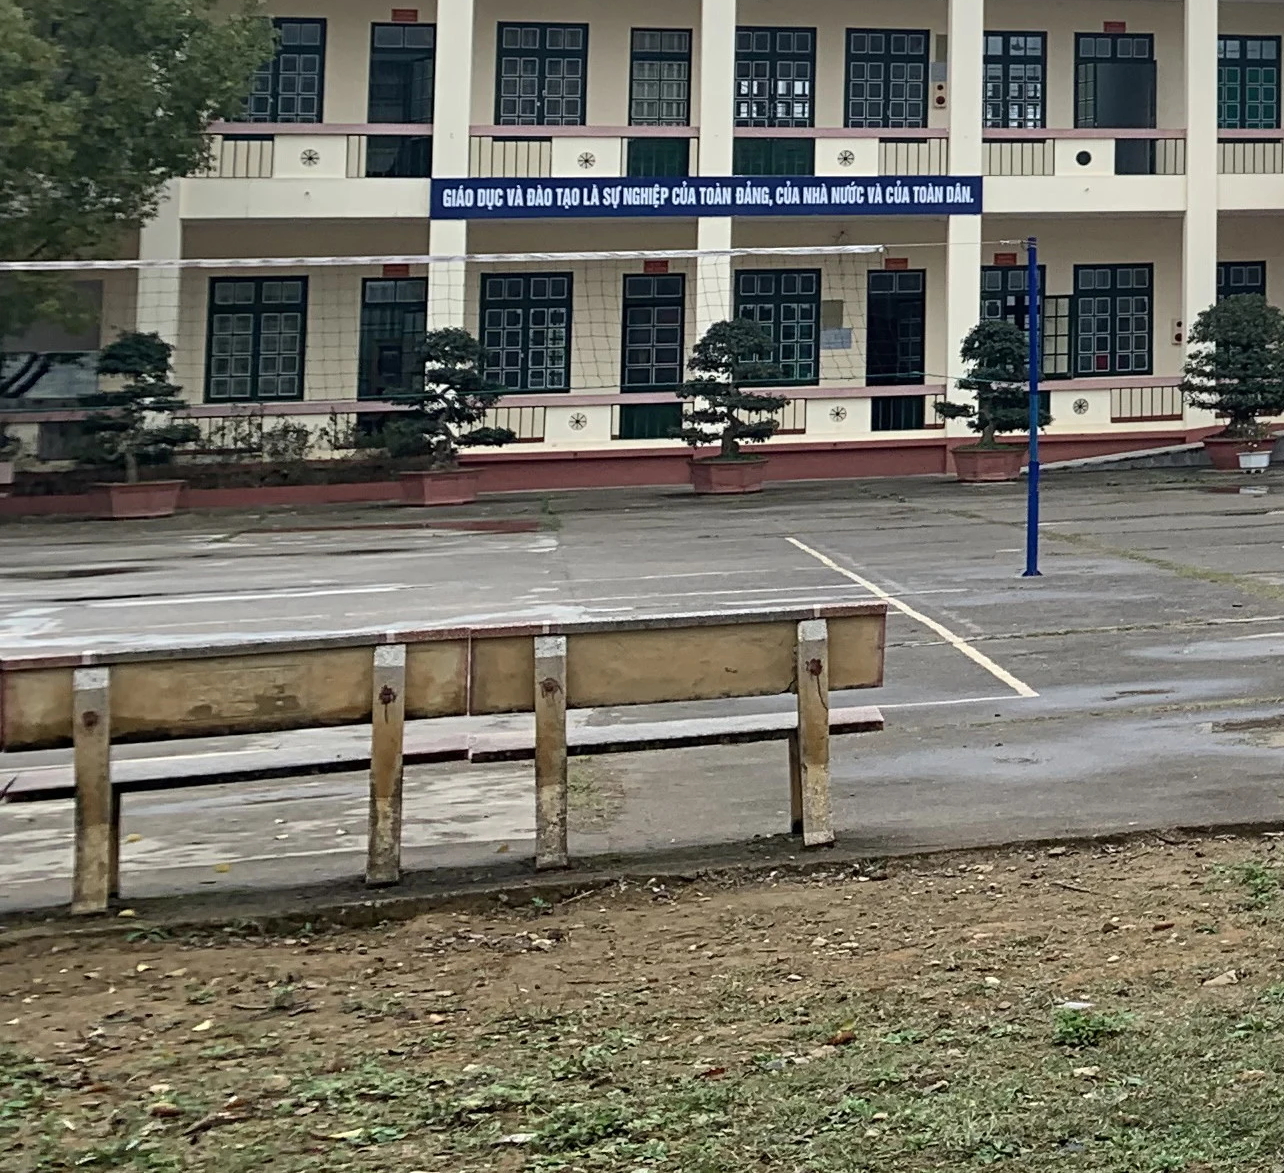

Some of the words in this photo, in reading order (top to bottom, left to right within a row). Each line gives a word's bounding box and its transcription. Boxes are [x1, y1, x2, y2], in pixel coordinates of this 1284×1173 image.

[442, 185, 474, 208] GIÁO
[476, 187, 504, 211] DỤC
[506, 184, 524, 207] VÀ
[526, 184, 552, 207] ĐÀO
[556, 187, 580, 209] TẠO
[582, 184, 600, 206] LÀ
[602, 185, 622, 209] SỰ
[622, 183, 669, 209] NGHIỆP
[671, 180, 696, 206] CỦA
[699, 182, 732, 206] TOÀN
[735, 180, 773, 207] ĐẢNG,
[775, 180, 800, 205] CỦA
[802, 183, 829, 205] NHÀ
[830, 181, 865, 205] NƯỚC
[867, 183, 883, 204] VÀ
[885, 180, 910, 204] CỦA
[912, 183, 943, 204] TOÀN
[945, 182, 974, 204] DÂN.
